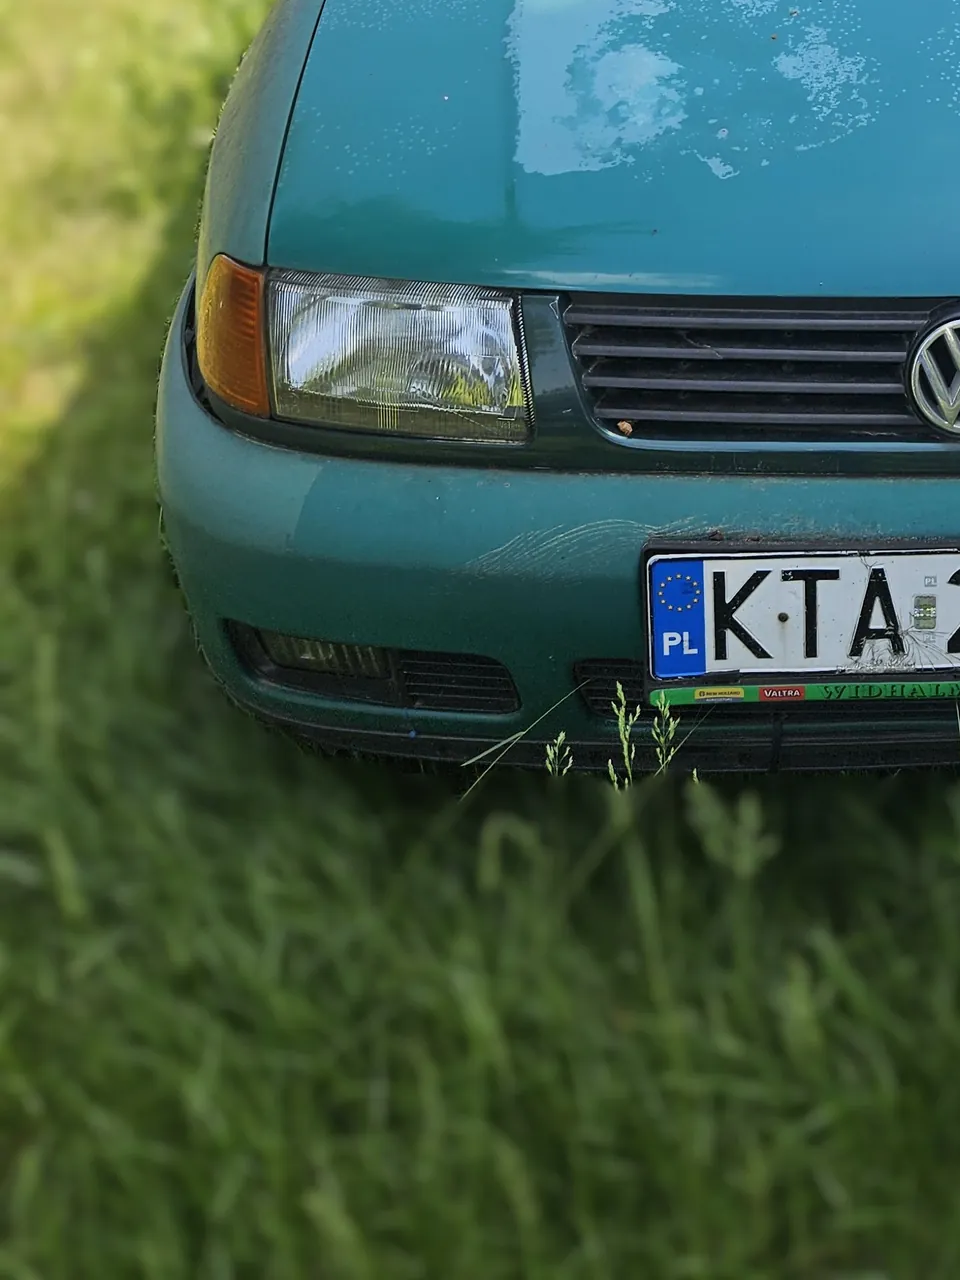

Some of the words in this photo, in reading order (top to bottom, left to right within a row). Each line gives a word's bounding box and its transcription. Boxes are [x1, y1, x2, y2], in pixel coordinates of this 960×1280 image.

[713, 567, 906, 661] KTA
[662, 631, 698, 656] PL
[764, 688, 800, 697] VALTRA
